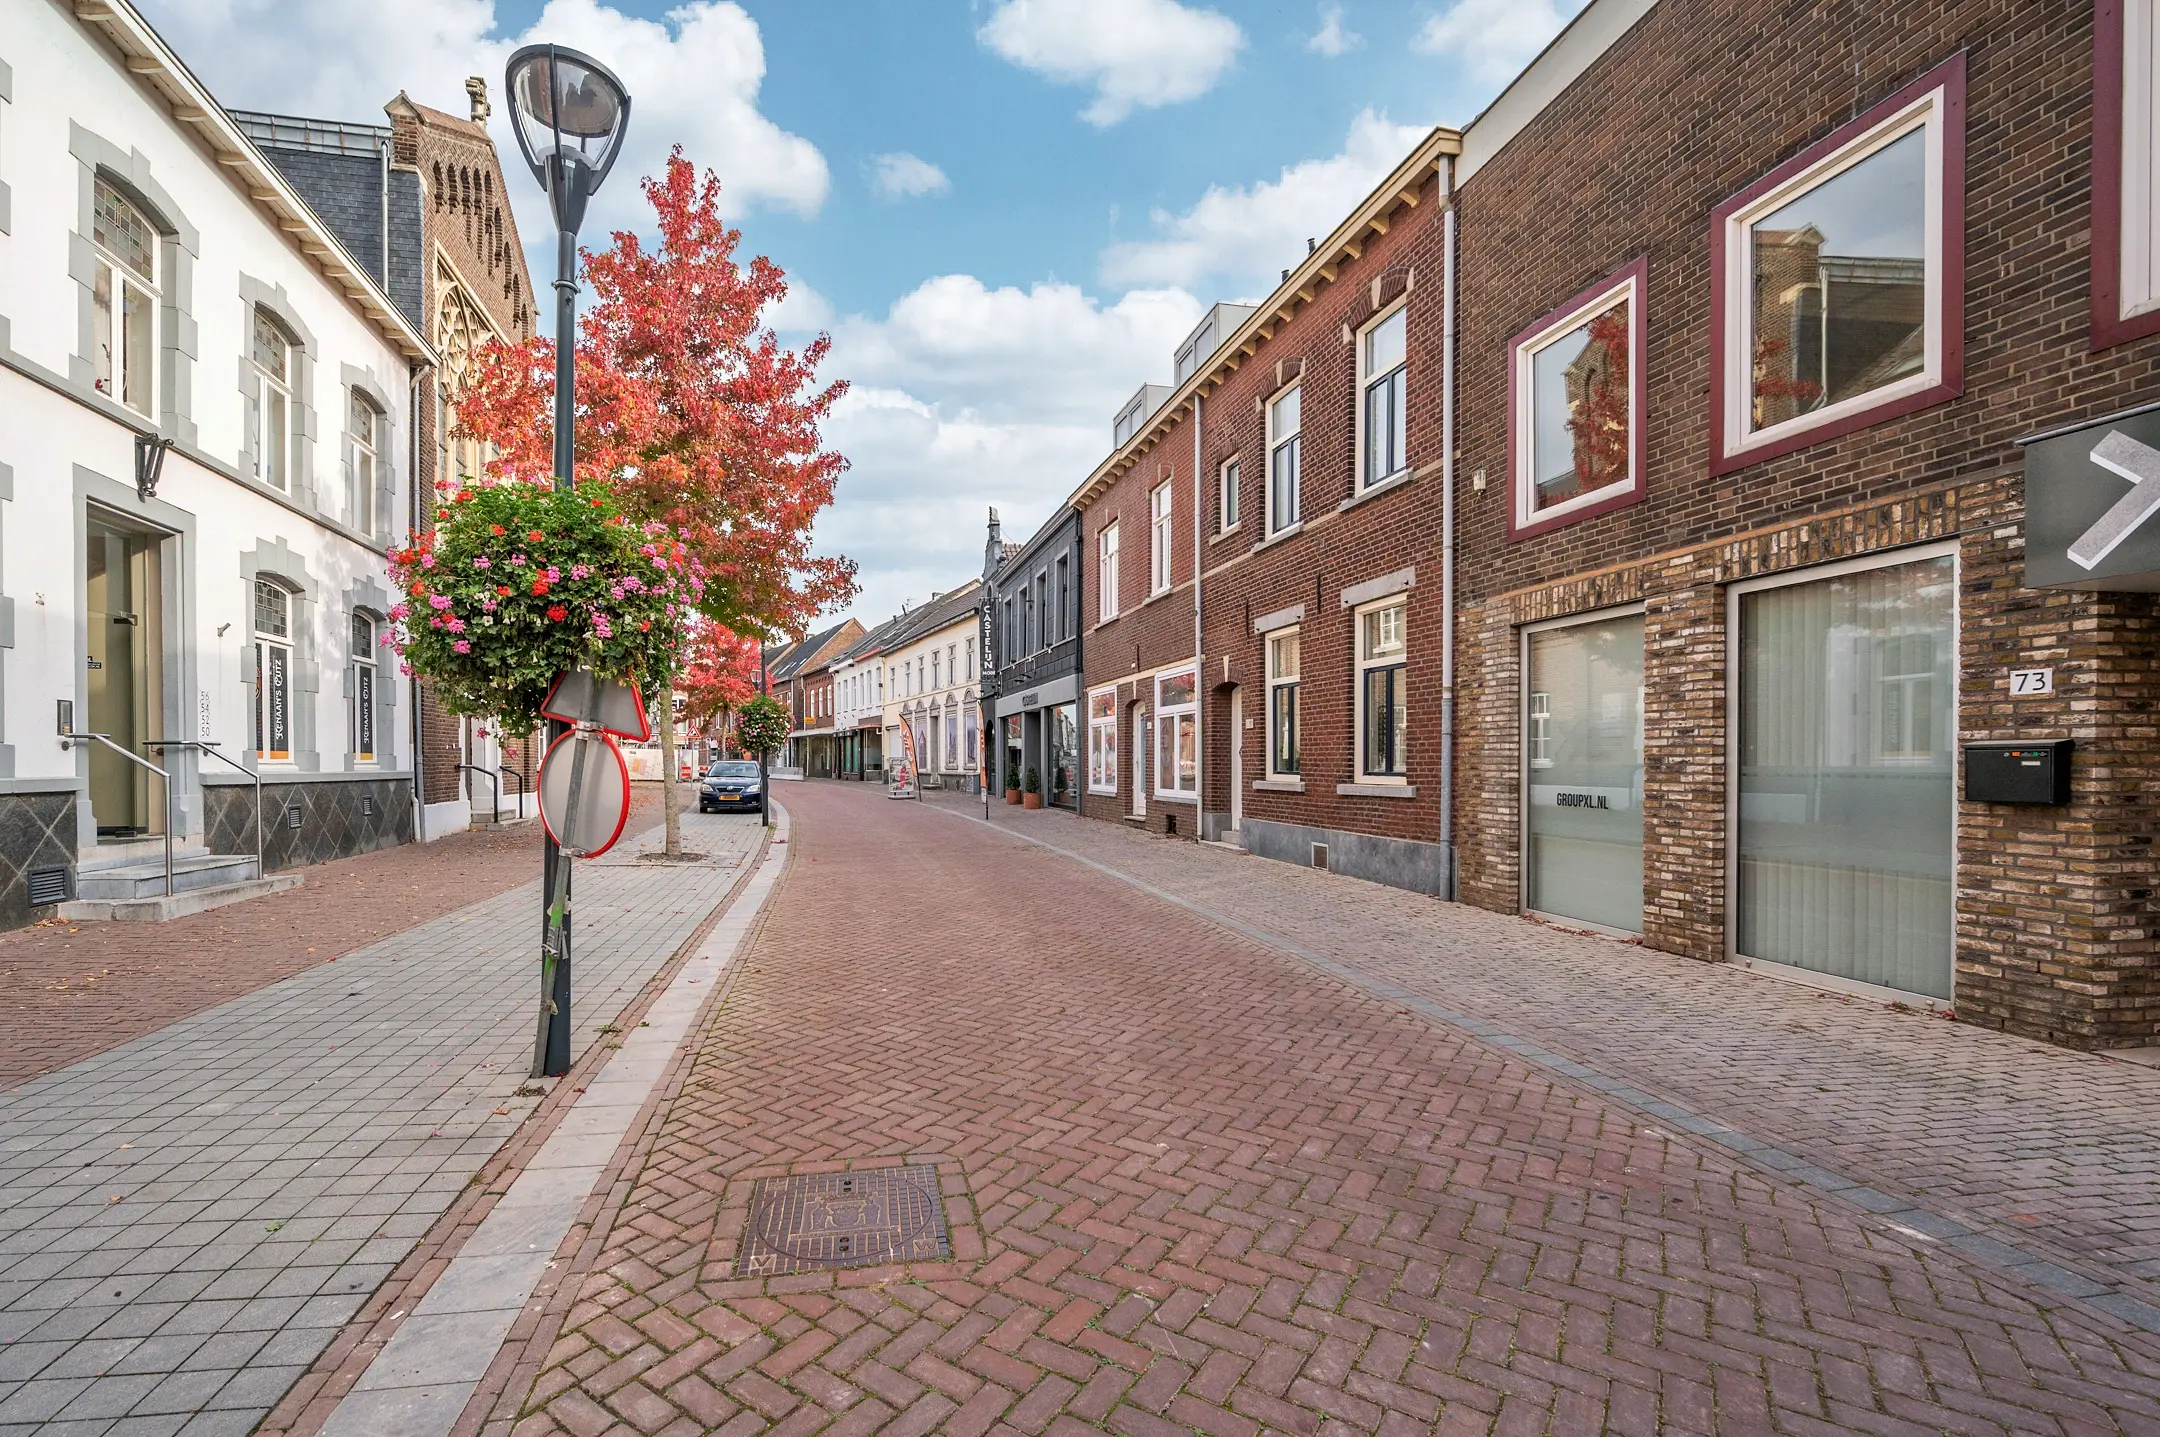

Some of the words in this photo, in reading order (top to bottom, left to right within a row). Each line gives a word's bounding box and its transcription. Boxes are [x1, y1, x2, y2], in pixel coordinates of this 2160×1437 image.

[274, 659, 283, 687] CUTZ
[2014, 672, 2046, 692] 73
[200, 691, 210, 701] 56
[200, 703, 210, 713] 54
[201, 715, 210, 725] 52
[201, 726, 211, 737] 50
[1557, 793, 1609, 809] GROUPXL.NL
[753, 1256, 768, 1267] V
